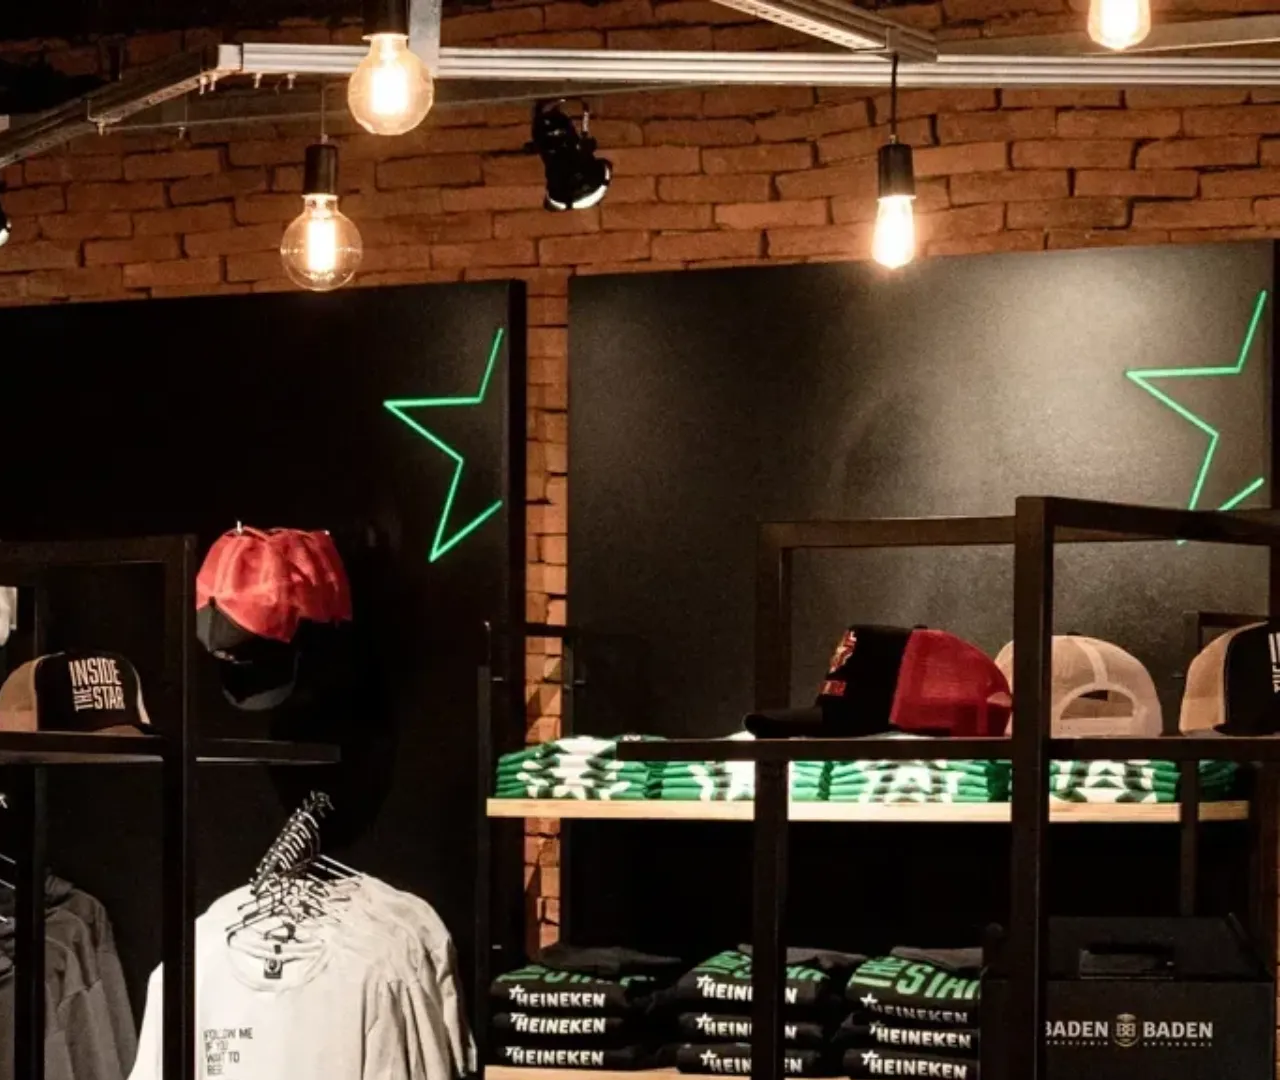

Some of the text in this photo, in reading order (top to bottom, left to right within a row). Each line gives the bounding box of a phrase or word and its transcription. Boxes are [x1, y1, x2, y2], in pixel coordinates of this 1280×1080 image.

[68, 656, 122, 687] INSIDE
[93, 685, 126, 710] STAR
[516, 992, 606, 1008] HEINEKEN
[702, 982, 798, 1004] HEINN
[238, 1027, 253, 1040] ME
[515, 1017, 606, 1034] HEINEKEN
[704, 1021, 797, 1040] HEINN
[1142, 1021, 1214, 1038] BADEN
[876, 1026, 972, 1048] HEINEKEN
[228, 1051, 240, 1063] TO
[512, 1049, 605, 1066] HEINEKEN
[710, 1057, 803, 1074] HEINN
[869, 1057, 968, 1080] HEINEKEN
